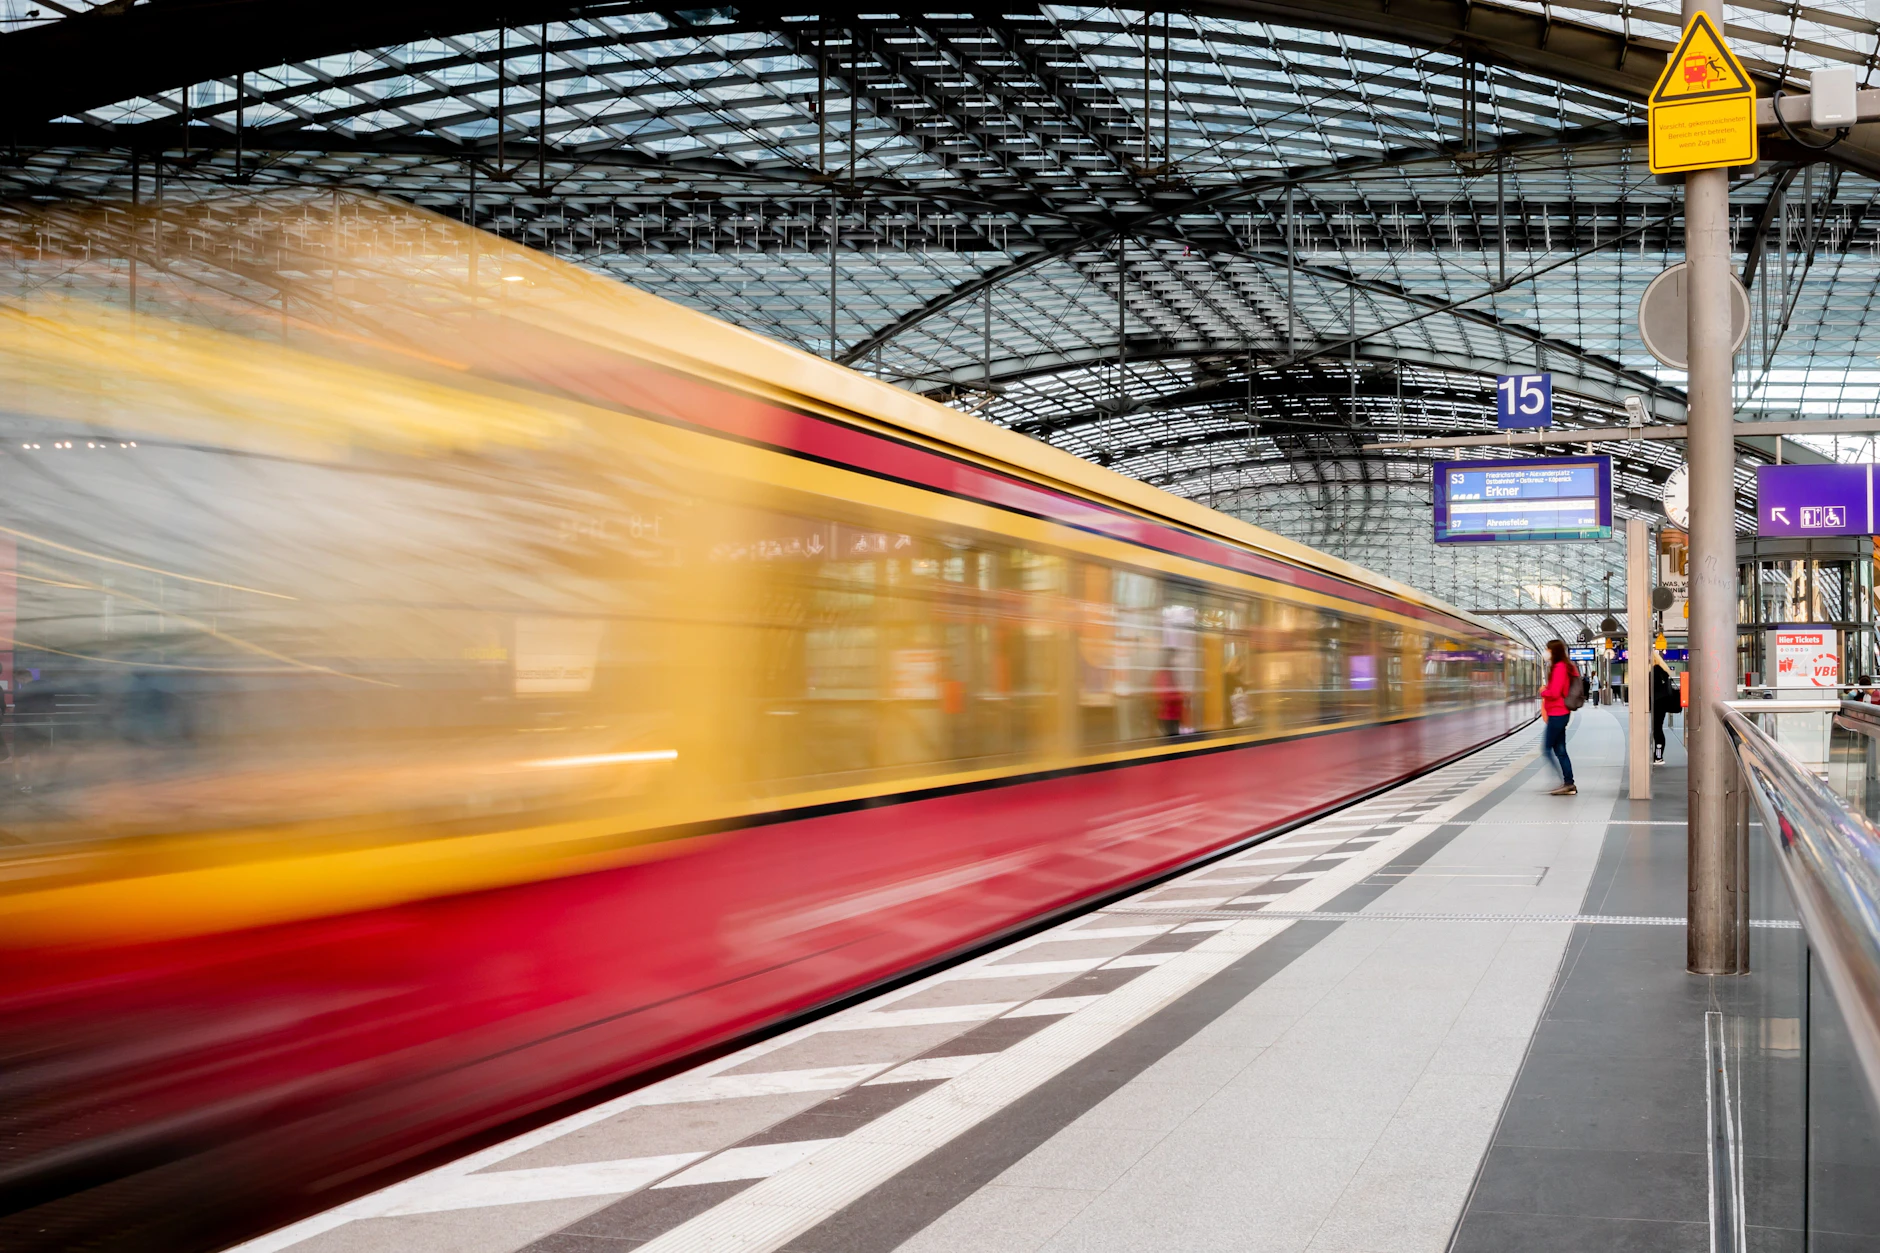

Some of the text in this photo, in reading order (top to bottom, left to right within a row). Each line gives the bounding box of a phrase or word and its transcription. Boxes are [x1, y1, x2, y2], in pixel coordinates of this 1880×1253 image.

[1659, 116, 1746, 131] Vorsicht, gekennzeichneten
[1668, 132, 1692, 140] Bereich
[1708, 127, 1737, 136] betreten,
[1499, 376, 1544, 414] 15
[1452, 474, 1464, 484] S3
[1530, 470, 1570, 478] Alexanderplatz
[1486, 486, 1520, 496] Erkner
[1452, 520, 1462, 528] S7
[1486, 518, 1529, 526] Ahrensfelde
[1814, 666, 1836, 676] VBB
